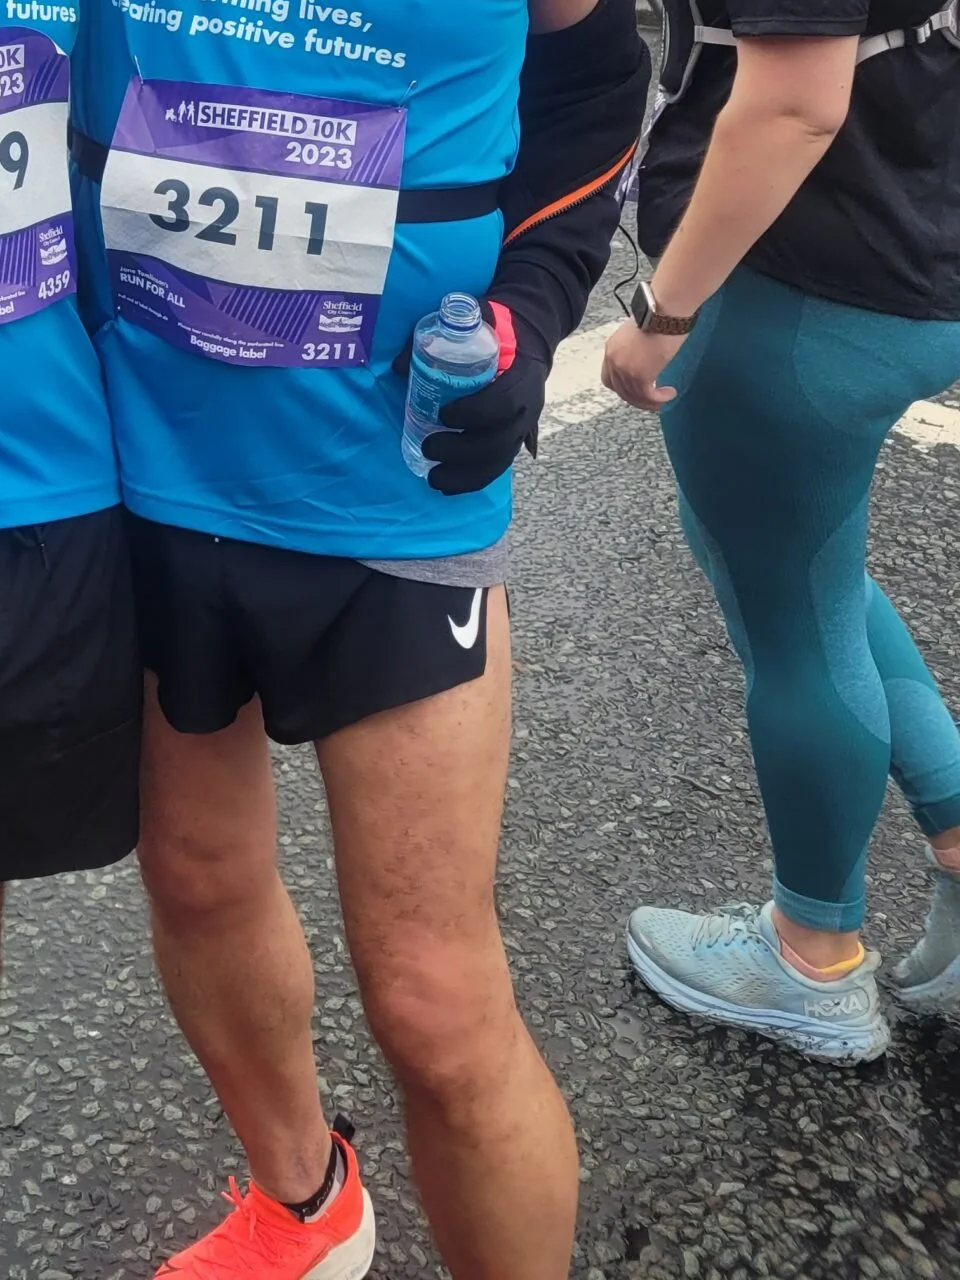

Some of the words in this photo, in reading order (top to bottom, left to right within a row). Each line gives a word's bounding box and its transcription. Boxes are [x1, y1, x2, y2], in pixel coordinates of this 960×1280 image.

[189, 14, 295, 50] positive
[304, 28, 408, 69] futures
[199, 104, 309, 136] SHEFFIELD
[312, 119, 354, 142] 10K
[284, 141, 353, 170] 2023
[148, 178, 329, 256] 3211
[38, 270, 71, 300] 4359
[119, 272, 145, 289] RUN
[145, 280, 165, 299] FOR
[166, 291, 186, 309] ALL
[322, 300, 363, 312] Sheffield
[190, 334, 237, 357] Baggage
[239, 346, 267, 359] label
[301, 342, 356, 361] 3211
[803, 994, 863, 1017] HOKA
